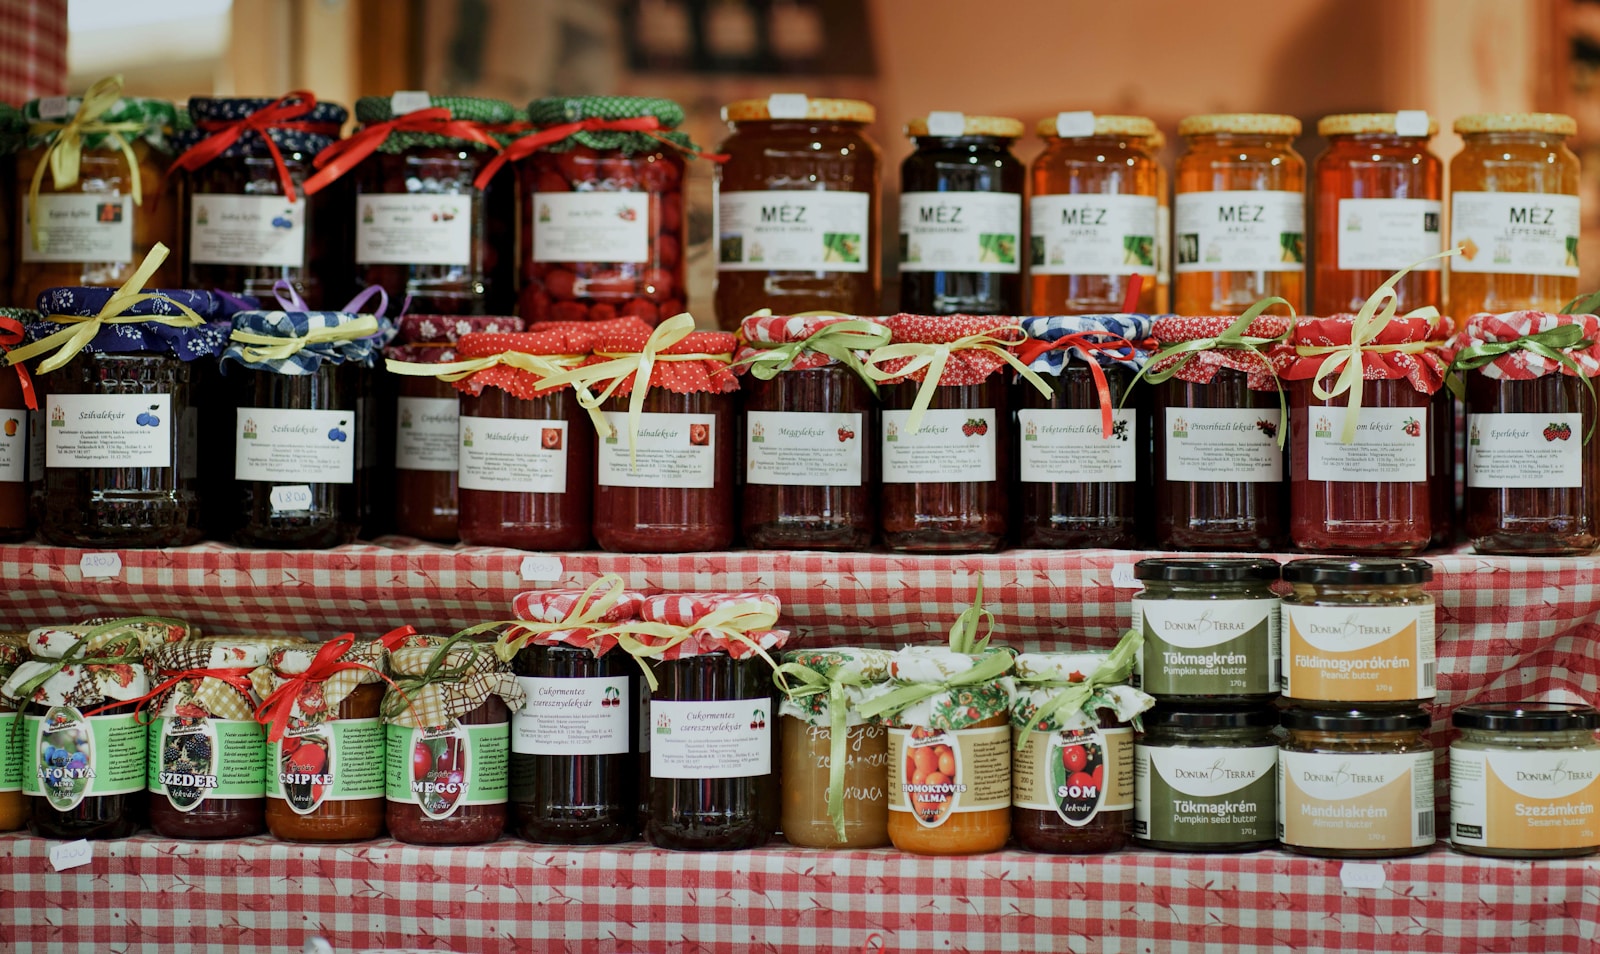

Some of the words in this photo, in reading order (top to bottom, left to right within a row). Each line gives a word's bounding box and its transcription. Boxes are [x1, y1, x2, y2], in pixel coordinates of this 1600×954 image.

[761, 201, 807, 223] MÉZ
[920, 201, 963, 223] MÉZ
[1062, 202, 1107, 225] MÉZ
[1219, 201, 1264, 223] MÉZ
[1510, 202, 1554, 225] MÉZ
[78, 410, 125, 421] Szilvalekvár
[271, 424, 318, 434] Szilvalekvár
[1040, 424, 1084, 434] Feketeribizli
[1190, 422, 1232, 431] Pirosribizli
[1233, 422, 1256, 432] lekvár
[1370, 421, 1393, 431] lekvár
[485, 432, 530, 443] Málnalekvár
[635, 428, 679, 438] álnalekvár
[778, 426, 825, 438] Meggylekvár
[1491, 428, 1531, 438] Eperlekvár
[278, 492, 307, 502] 1800
[1164, 620, 1197, 630] DONUM
[1214, 620, 1245, 630] TERRAE
[1310, 624, 1342, 634] DONUM
[1360, 624, 1391, 634] TERRAE
[1163, 652, 1247, 667] Tökmagkrém
[1296, 654, 1410, 672] Földimogyorókrém
[1164, 667, 1197, 677] Pumpkin
[1199, 667, 1218, 675] seed
[1220, 667, 1247, 675] butter
[1321, 671, 1350, 680] Peanut
[1352, 671, 1380, 680] butter
[538, 686, 586, 696] Cukormentes
[533, 698, 592, 709] cseresznyelekvár
[686, 711, 736, 721] Cukormentes
[680, 722, 742, 733] cseresznyelekvár
[37, 764, 97, 779] ÁFONYA
[1175, 768, 1208, 779] DONUM
[1226, 768, 1256, 779] TERRAE
[1517, 771, 1552, 782] DONUM
[1568, 771, 1594, 781] TERRAE
[158, 771, 219, 788] SZEDER
[278, 771, 334, 786] CSIPKE
[1303, 772, 1335, 783] DONUM
[1350, 772, 1384, 784] TERRAE
[412, 780, 469, 794] MEGGY
[902, 784, 966, 793] HOMOKTÖVIS
[1058, 786, 1097, 799] SOM
[172, 789, 195, 798] lekvár
[918, 794, 947, 802] ALMA
[426, 801, 451, 810] lekvár
[1064, 803, 1092, 813] lekvár
[1174, 800, 1257, 816] Tökmagkrém
[1300, 804, 1388, 818] Mandulakrém
[1514, 803, 1594, 817] Szezámkrém
[1174, 815, 1208, 825] Pumpkin
[1210, 815, 1231, 824] seed
[1232, 815, 1258, 824] butter
[1312, 818, 1343, 828] Almond
[1344, 819, 1374, 828] butter
[1528, 817, 1559, 827] Sesame
[1562, 817, 1586, 826] butter
